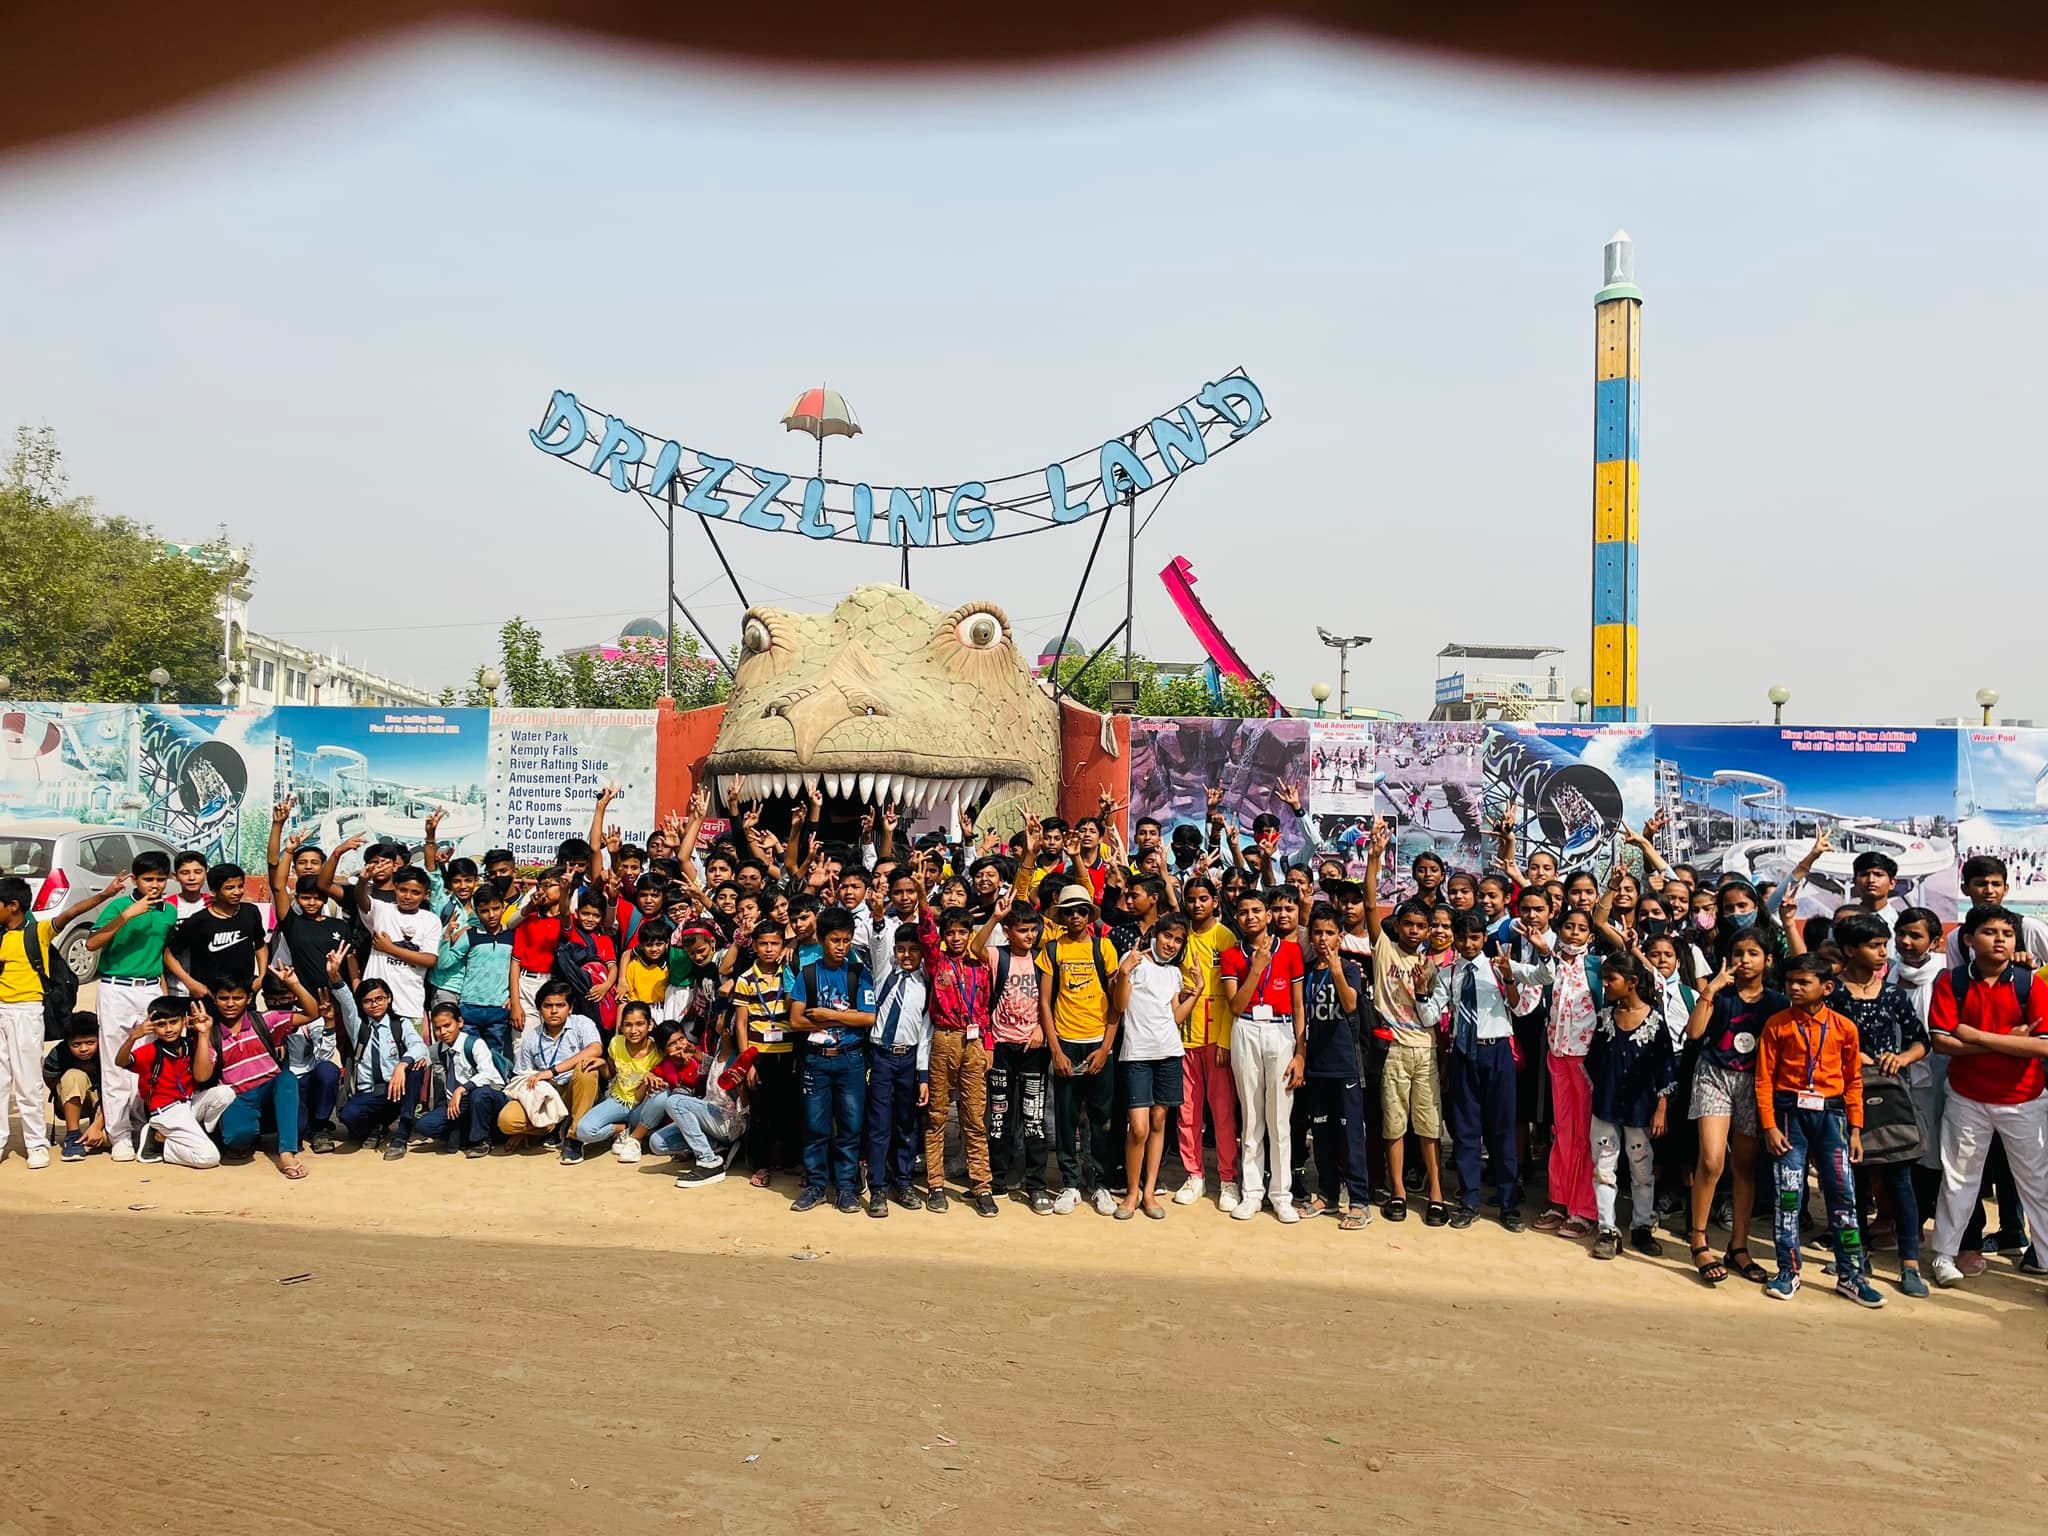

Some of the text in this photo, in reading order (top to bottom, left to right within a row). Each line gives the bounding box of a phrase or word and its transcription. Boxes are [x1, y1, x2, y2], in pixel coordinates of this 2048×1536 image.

[529, 375, 1266, 548] DRIZZLING LAND
[491, 711, 656, 727] Drizzling Land Highlights
[1313, 721, 1365, 730] Mud Adventure
[511, 730, 568, 742] Water Park
[1782, 730, 1802, 739] River
[1804, 731, 1834, 741] Rafting
[1835, 731, 1856, 740] Slide
[510, 745, 578, 757] Kempty Falls
[510, 759, 608, 772] River Rafting Slide
[509, 773, 598, 784] Amusement Park
[508, 786, 561, 798] Adventure
[564, 787, 598, 800] Sports
[508, 801, 522, 811] AC
[526, 801, 562, 812] Rooms
[508, 814, 571, 827] Party Lawns
[507, 828, 646, 842] AC Conference Hall
[213, 930, 241, 945] NIKE
[1306, 983, 1336, 1003] UST
